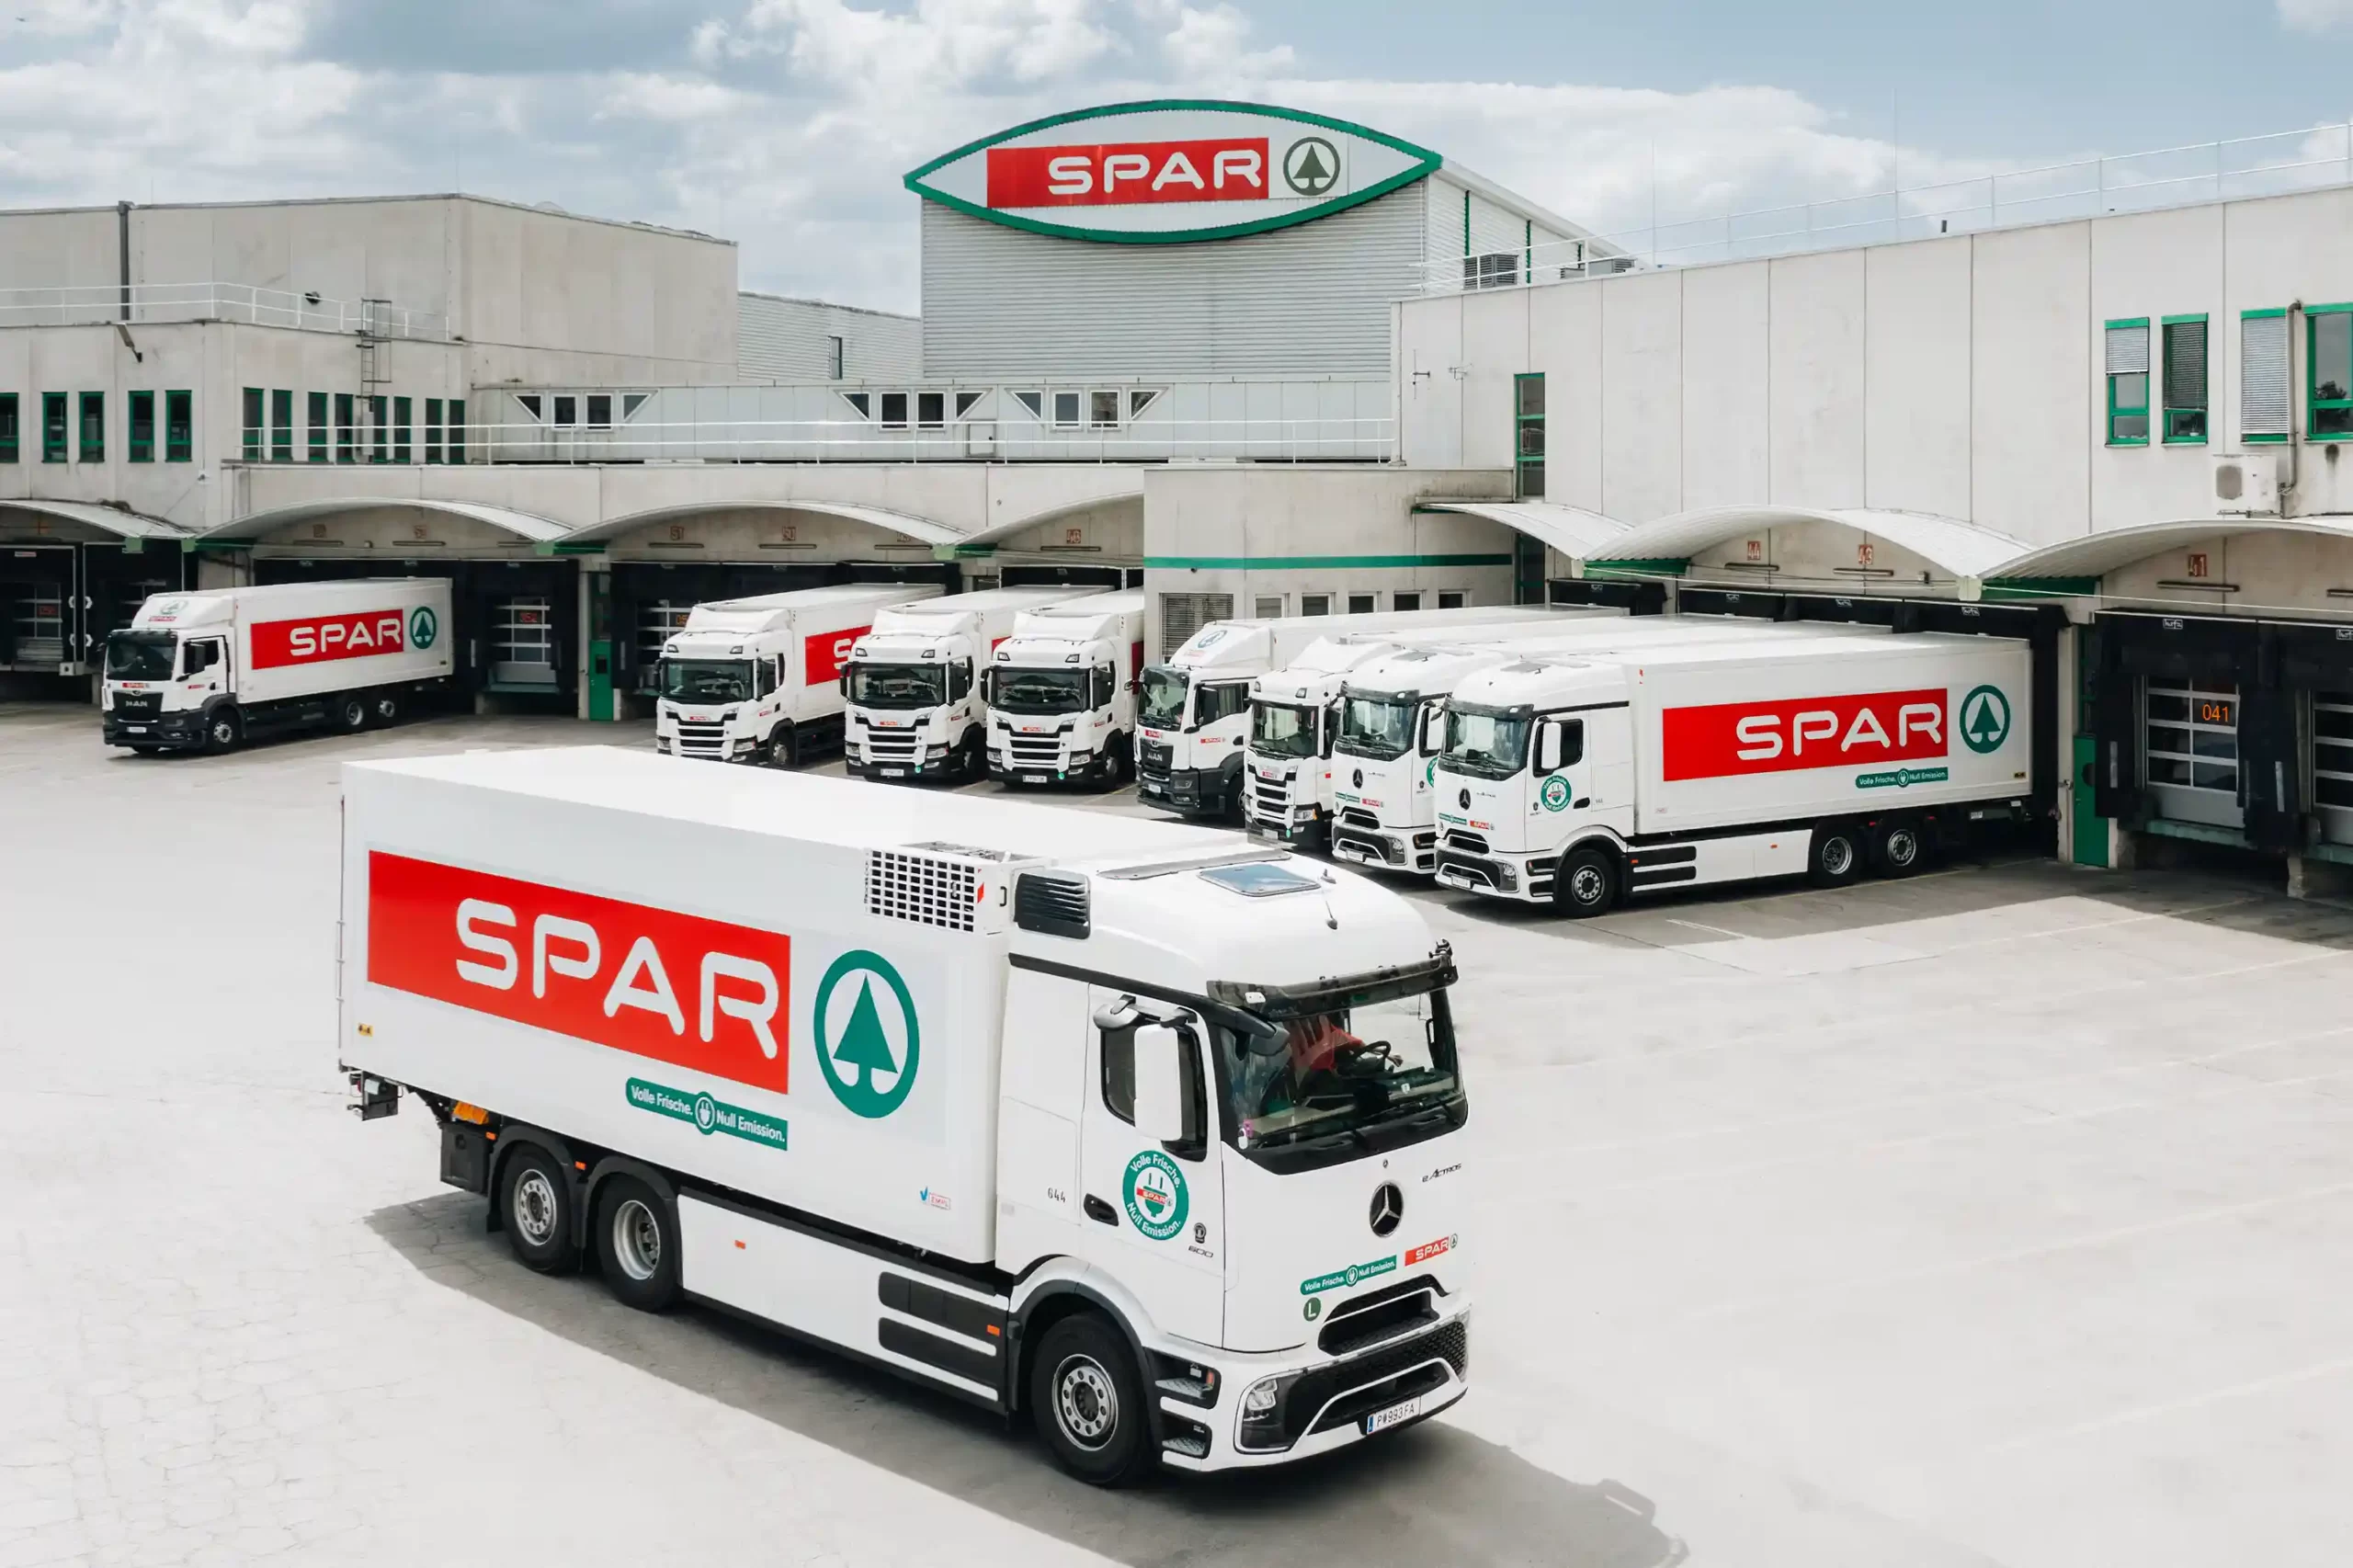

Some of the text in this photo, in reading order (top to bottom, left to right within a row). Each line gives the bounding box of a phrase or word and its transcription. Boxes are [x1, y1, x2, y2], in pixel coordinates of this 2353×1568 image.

[1048, 150, 1262, 195] SPAR
[1748, 541, 1760, 560] 44
[1859, 544, 1873, 565] 43
[2189, 555, 2207, 577] 41
[290, 618, 402, 656] SPAR
[2201, 703, 2229, 722] 041
[1736, 703, 1943, 761] SPAR
[455, 898, 779, 1060] SPAR
[631, 1085, 785, 1142] Volle Frische. Null Emission.
[1130, 1153, 1181, 1187] Volle Frische.
[1047, 1187, 1066, 1203] 644
[1142, 1190, 1166, 1204] SPAR
[1127, 1202, 1181, 1237] Null Emission.
[1415, 1238, 1449, 1260] SPAR
[1304, 1261, 1395, 1291] Volle Frische. Null Emission.
[1307, 1302, 1316, 1317] L
